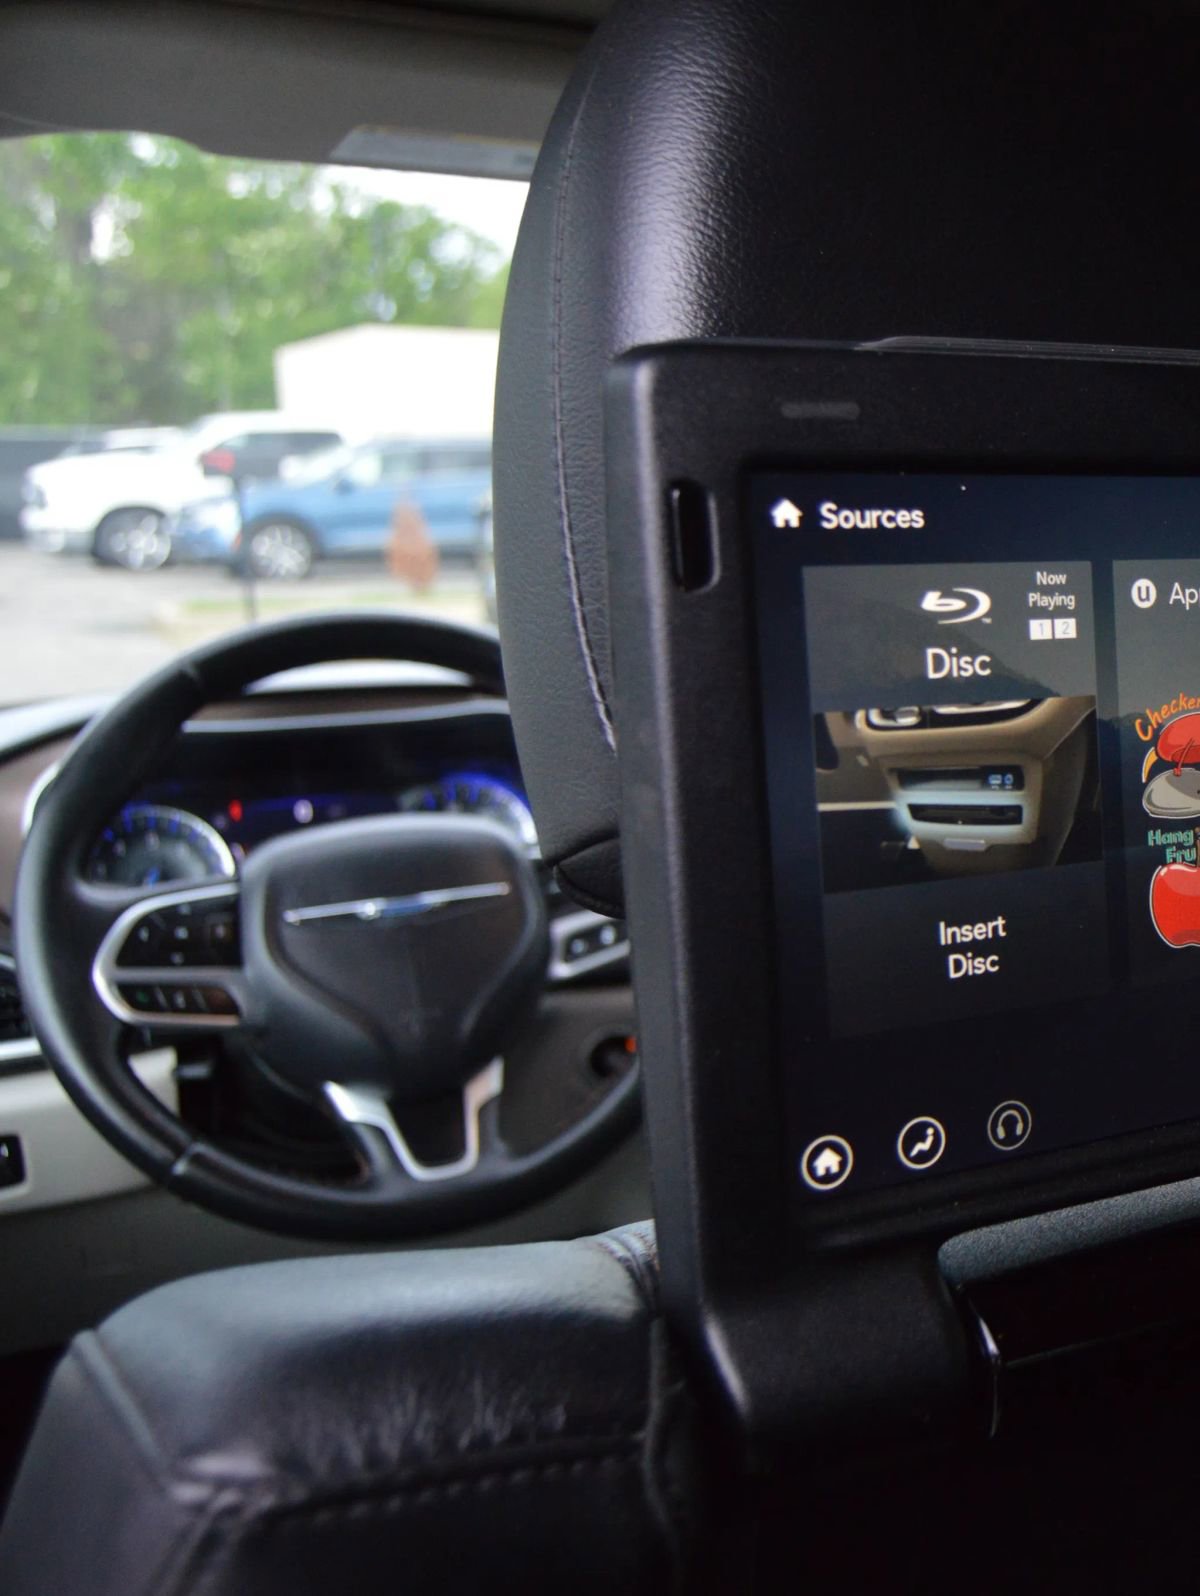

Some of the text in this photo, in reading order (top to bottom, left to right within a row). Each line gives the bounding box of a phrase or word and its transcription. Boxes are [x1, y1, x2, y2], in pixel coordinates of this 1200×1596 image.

[819, 502, 925, 529] Sources
[1036, 571, 1067, 586] Now
[1028, 592, 1075, 611] Playing
[926, 646, 992, 679] Disc
[939, 916, 1007, 945] Insert
[948, 952, 1000, 979] Disc
